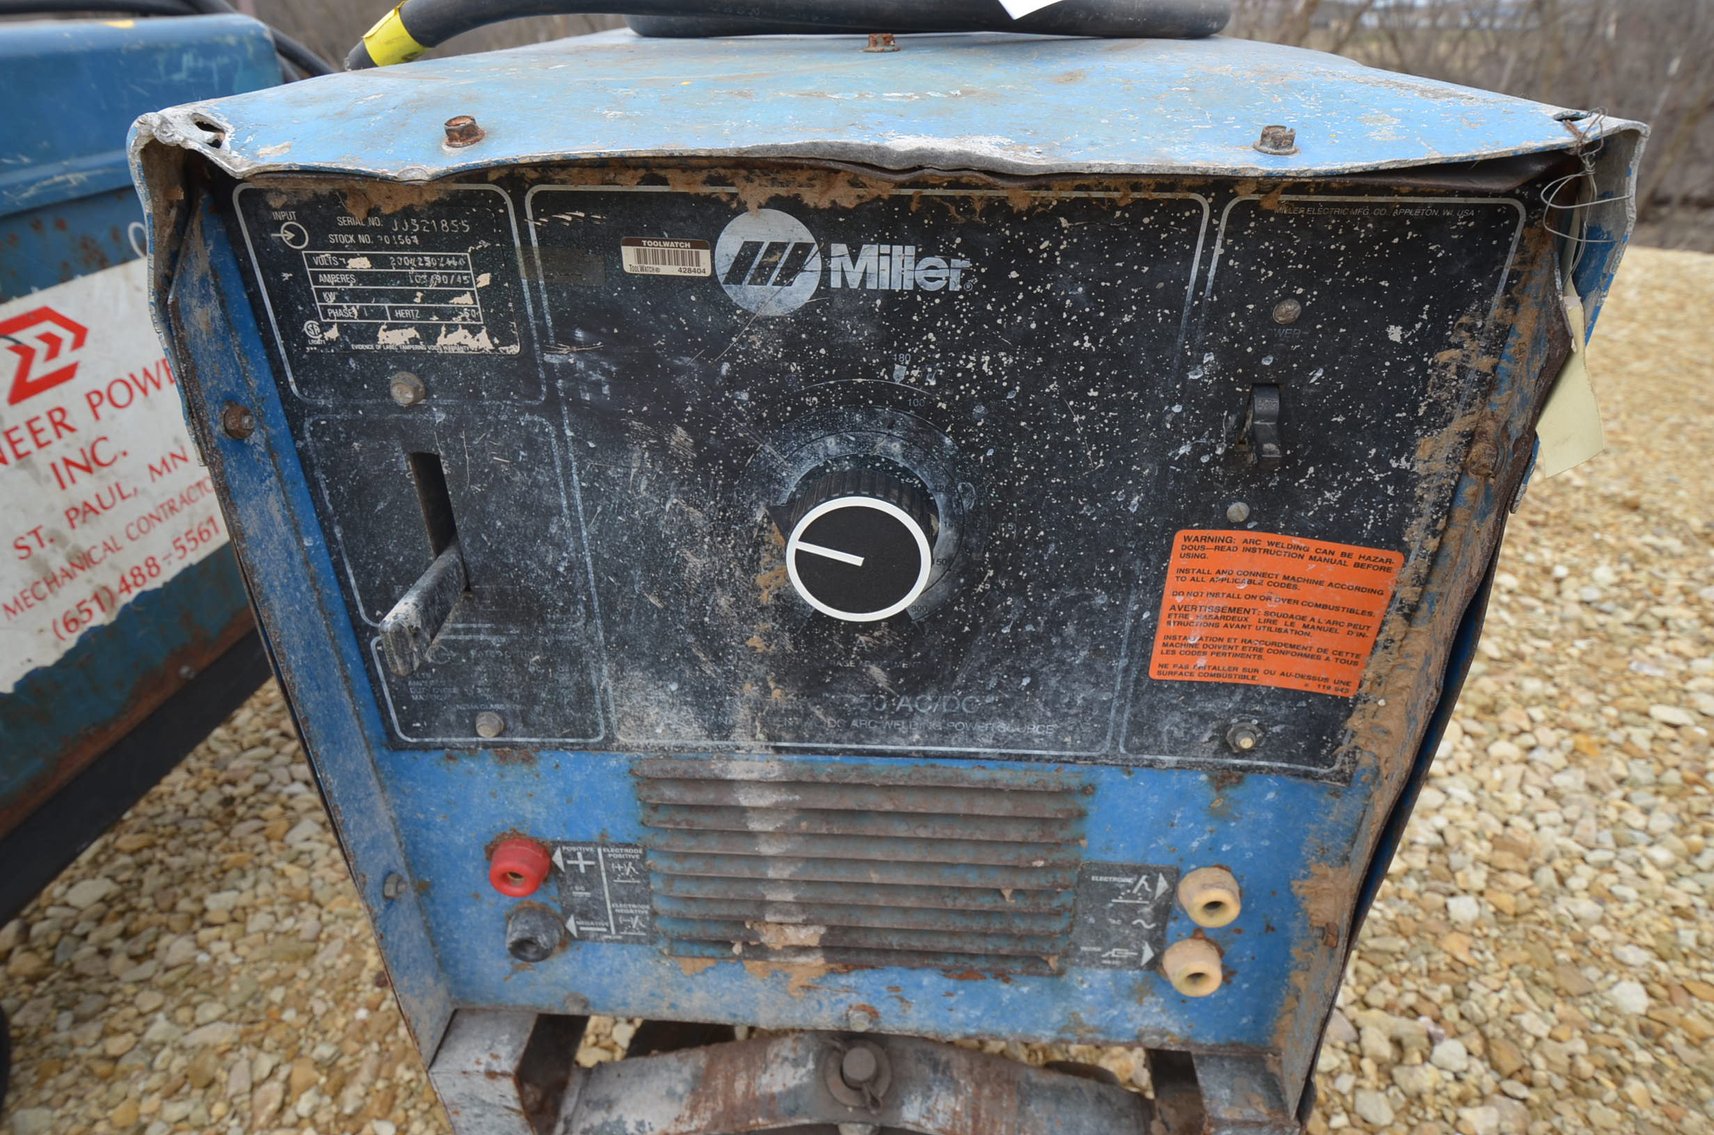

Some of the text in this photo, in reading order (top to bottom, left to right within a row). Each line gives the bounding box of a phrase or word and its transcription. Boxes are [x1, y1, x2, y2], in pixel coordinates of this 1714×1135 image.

[272, 211, 296, 220] INPUT
[336, 216, 365, 226] SERIAL
[368, 216, 384, 227] NO.
[328, 234, 354, 244] STOCK
[358, 234, 374, 244] NO.
[642, 240, 691, 248] TOOLWATCH
[312, 256, 339, 266] VOLTS
[830, 243, 970, 292] Miller
[318, 274, 356, 284] AMPERES
[327, 308, 354, 318] PHASE
[394, 309, 420, 319] HERTZ
[1266, 328, 1302, 338] WER
[50, 436, 128, 491] INC.
[13, 446, 190, 561] ST. PAUL, MN
[1180, 552, 1208, 560] USING.
[1183, 535, 1395, 564] WARNING: ARC WELDING CAN BE HAZAR-
[1242, 546, 1304, 560] INSTRUCTION
[1308, 555, 1348, 567] MANUAL
[1353, 562, 1393, 573] BEFORE
[2, 535, 124, 621] MECHANICAL
[1208, 576, 1264, 586] APPLICABLE
[1266, 580, 1300, 591] CODES.
[1236, 570, 1280, 580] CONNECT
[1282, 574, 1325, 587] MACHINE
[1328, 582, 1384, 596] ACCORDING
[1186, 590, 1204, 598] NOT
[1206, 592, 1242, 600] INSTALL
[1274, 596, 1300, 606] OVER
[1301, 600, 1376, 618] COMBUSTIBLES.
[1168, 604, 1260, 616] AVERTISSEMENT:
[1264, 610, 1308, 622] SOUDAGE
[1347, 622, 1372, 631] PEUT
[1168, 612, 1190, 620] ETRE
[1284, 620, 1296, 628] LE
[1302, 623, 1340, 634] MANUEL
[1166, 620, 1220, 628] STRUCTIONS
[1255, 626, 1312, 638] UTILISATION.
[1240, 638, 1313, 652] RACCORDEMENT
[1332, 650, 1362, 660] CETTE
[1242, 646, 1264, 654] ETRE
[1266, 648, 1322, 660] CONFORMES
[1335, 658, 1360, 667] TOUS
[1280, 672, 1330, 682] AU-DESSUS
[1334, 680, 1352, 688] UNE
[895, 695, 980, 714] AC/DC
